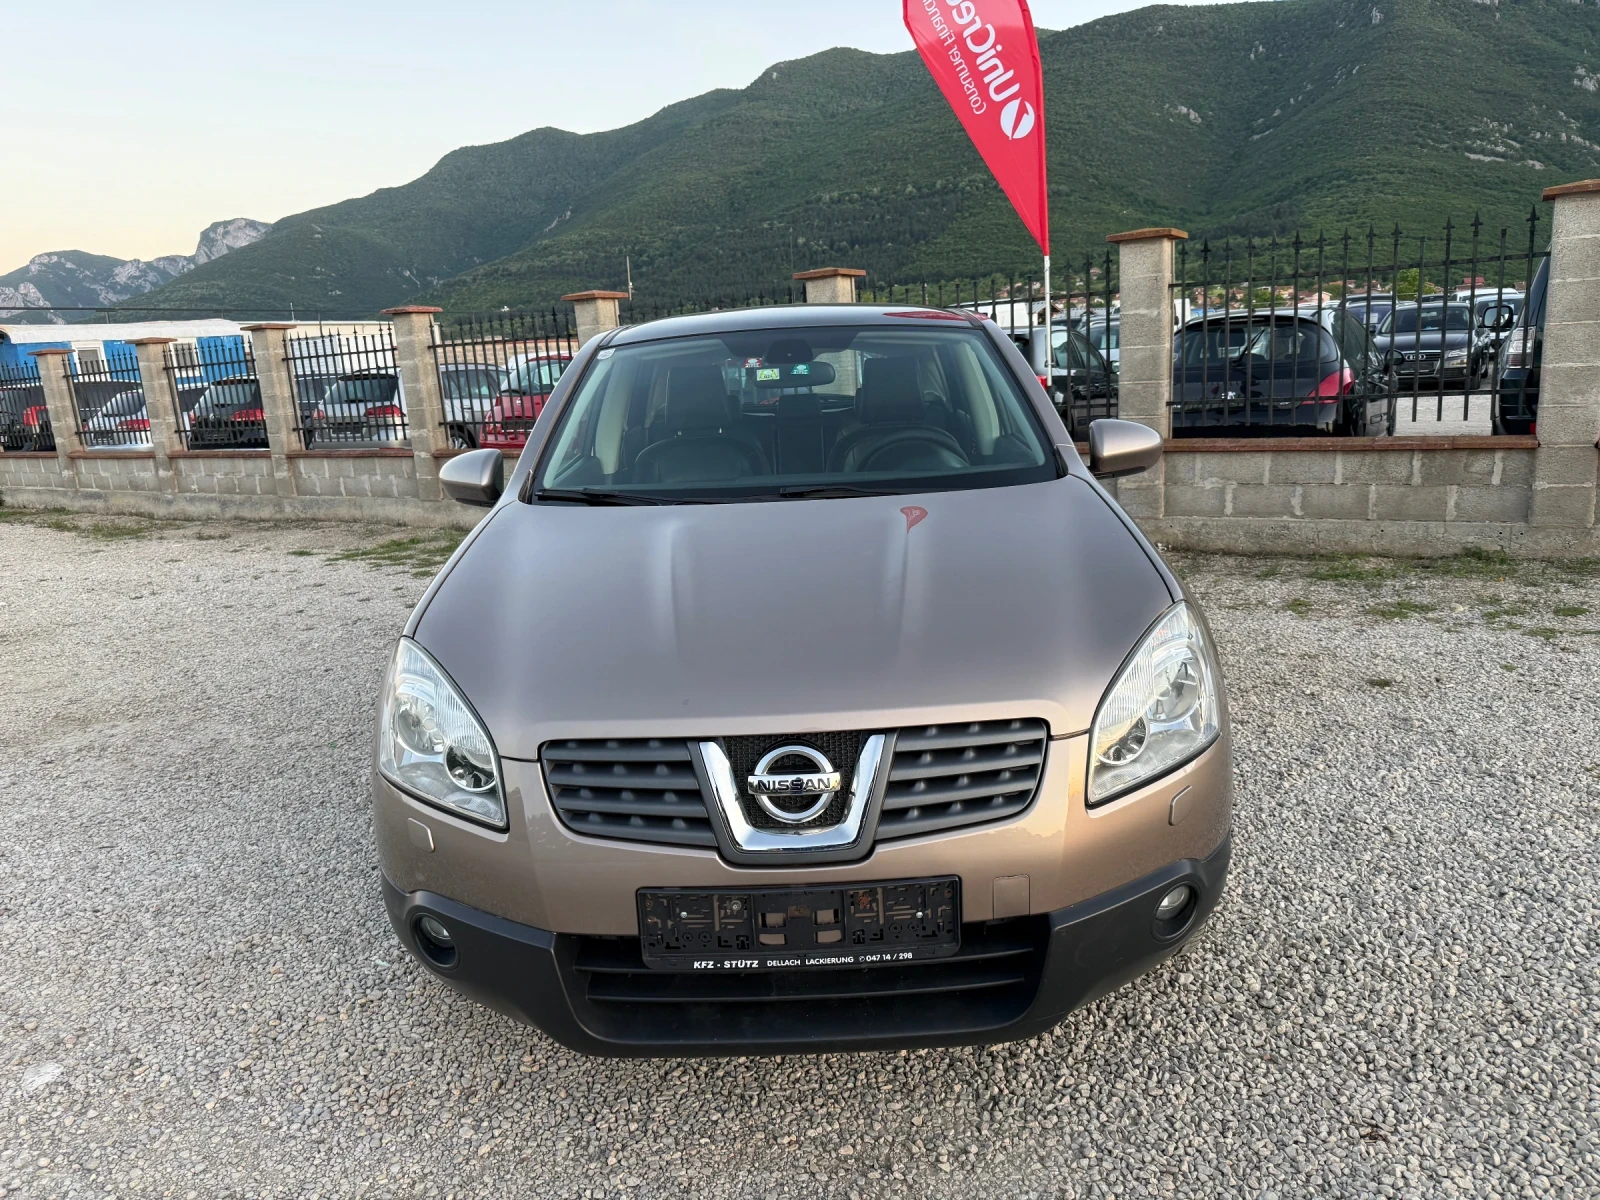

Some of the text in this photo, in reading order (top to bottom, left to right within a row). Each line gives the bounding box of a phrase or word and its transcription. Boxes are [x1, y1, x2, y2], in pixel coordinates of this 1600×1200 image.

[757, 777, 831, 792] NISSAN
[693, 961, 715, 969] KFZ
[723, 959, 759, 968] STÜTZ
[766, 959, 801, 967] DELLACH
[805, 956, 854, 965] LACKIERUNG
[865, 954, 881, 962] 047
[882, 953, 891, 961] 14
[898, 952, 913, 960] 298
